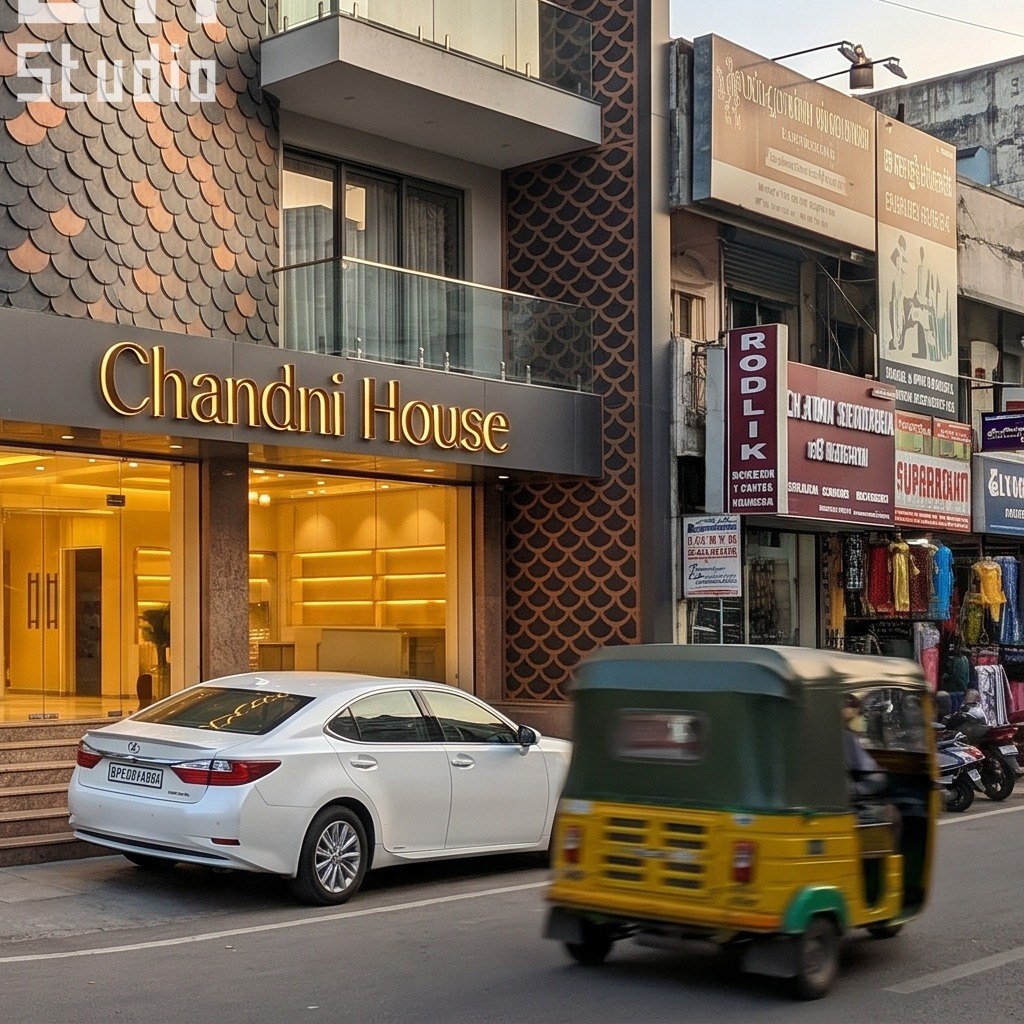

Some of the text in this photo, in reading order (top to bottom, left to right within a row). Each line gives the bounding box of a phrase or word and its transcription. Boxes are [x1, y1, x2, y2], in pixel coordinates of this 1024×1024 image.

[99, 341, 511, 454] Chandni House
[739, 332, 767, 461] RODLIK
